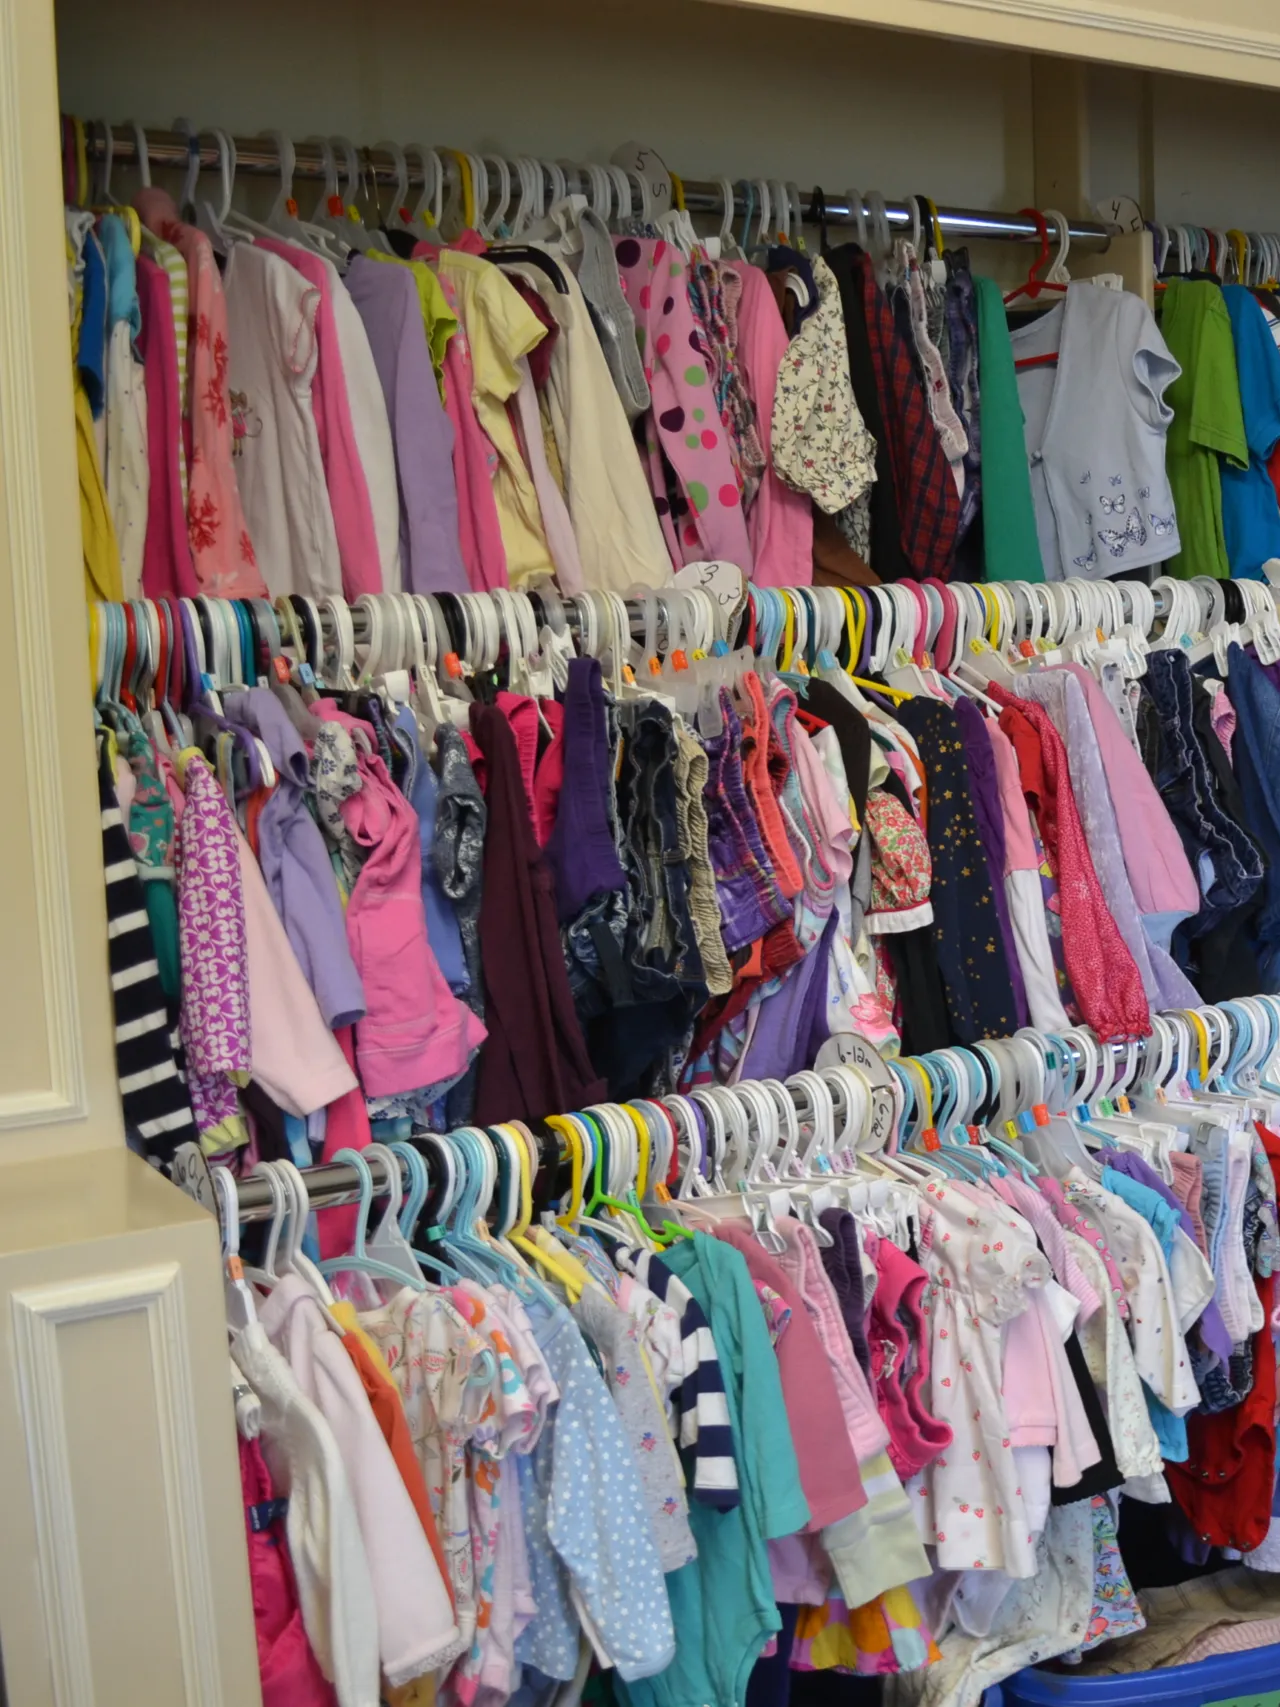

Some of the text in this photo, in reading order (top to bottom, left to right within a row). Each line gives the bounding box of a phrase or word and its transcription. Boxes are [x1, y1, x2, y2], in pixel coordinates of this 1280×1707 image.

[634, 150, 649, 172] 5
[1111, 200, 1121, 220] 4
[699, 564, 719, 585] 3
